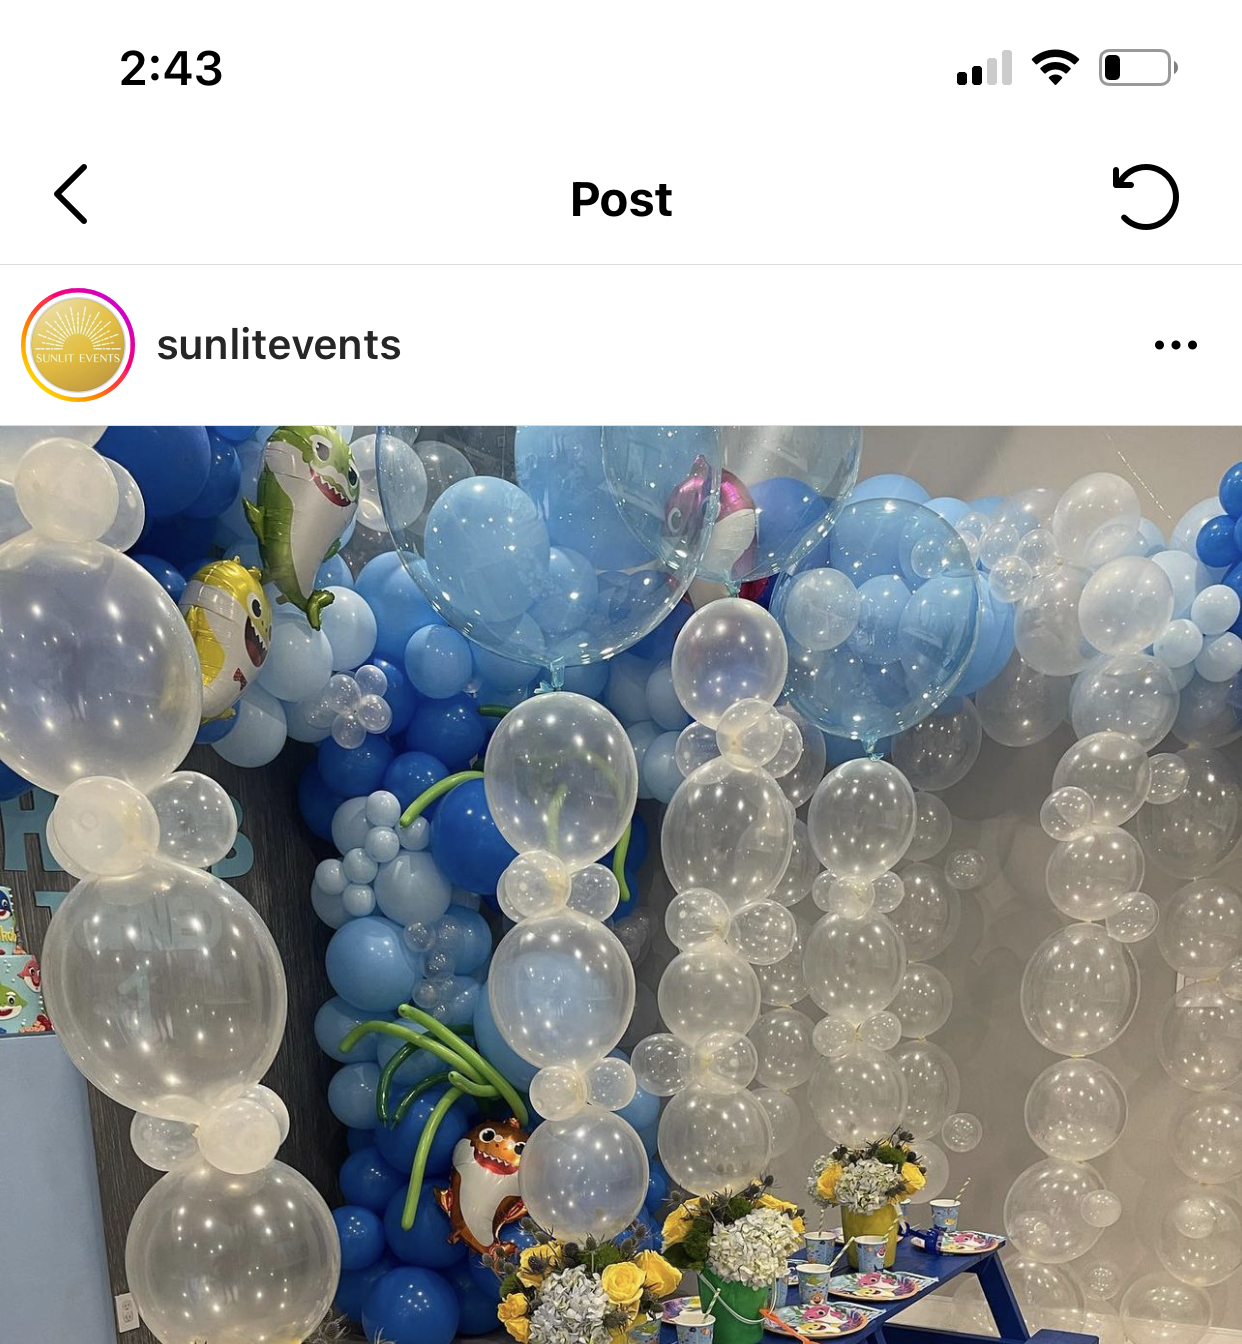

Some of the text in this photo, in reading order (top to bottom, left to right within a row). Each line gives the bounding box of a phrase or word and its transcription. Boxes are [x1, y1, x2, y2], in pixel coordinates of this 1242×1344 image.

[121, 50, 222, 86] 2:43
[573, 182, 672, 217] Post
[36, 353, 121, 363] SUNLIT EVENTS
[158, 327, 400, 360] sunlitevents
